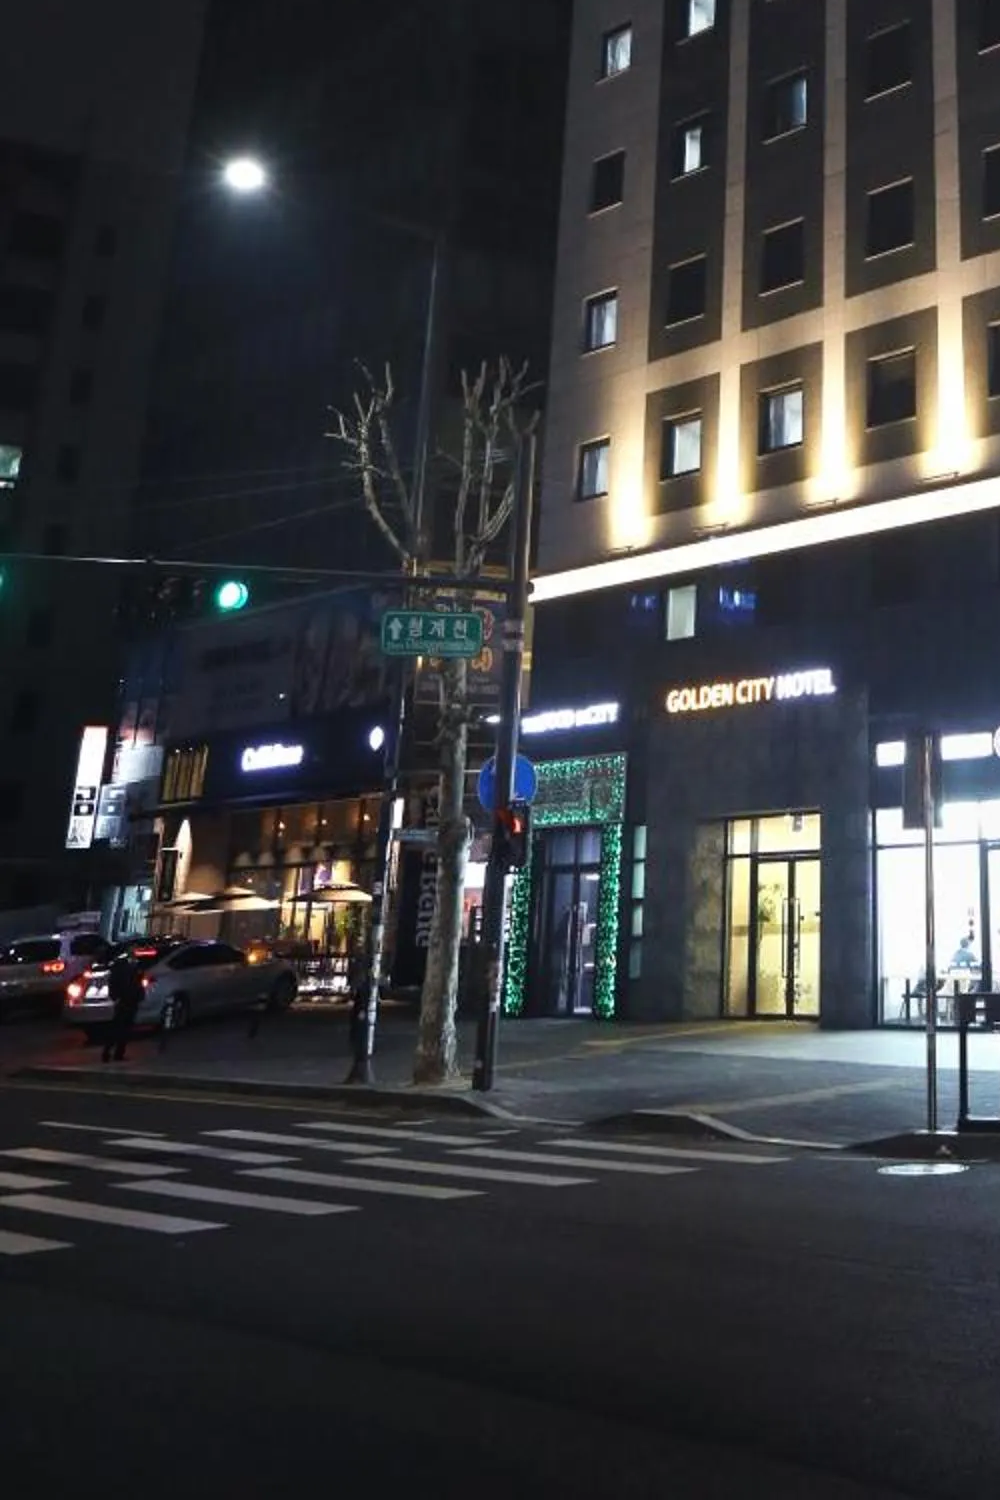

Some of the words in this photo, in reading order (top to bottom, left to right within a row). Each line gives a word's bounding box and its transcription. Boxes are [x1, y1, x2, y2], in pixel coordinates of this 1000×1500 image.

[666, 682, 733, 713] GOLDEN
[735, 677, 775, 704] CITY
[776, 668, 837, 700] HOTEL
